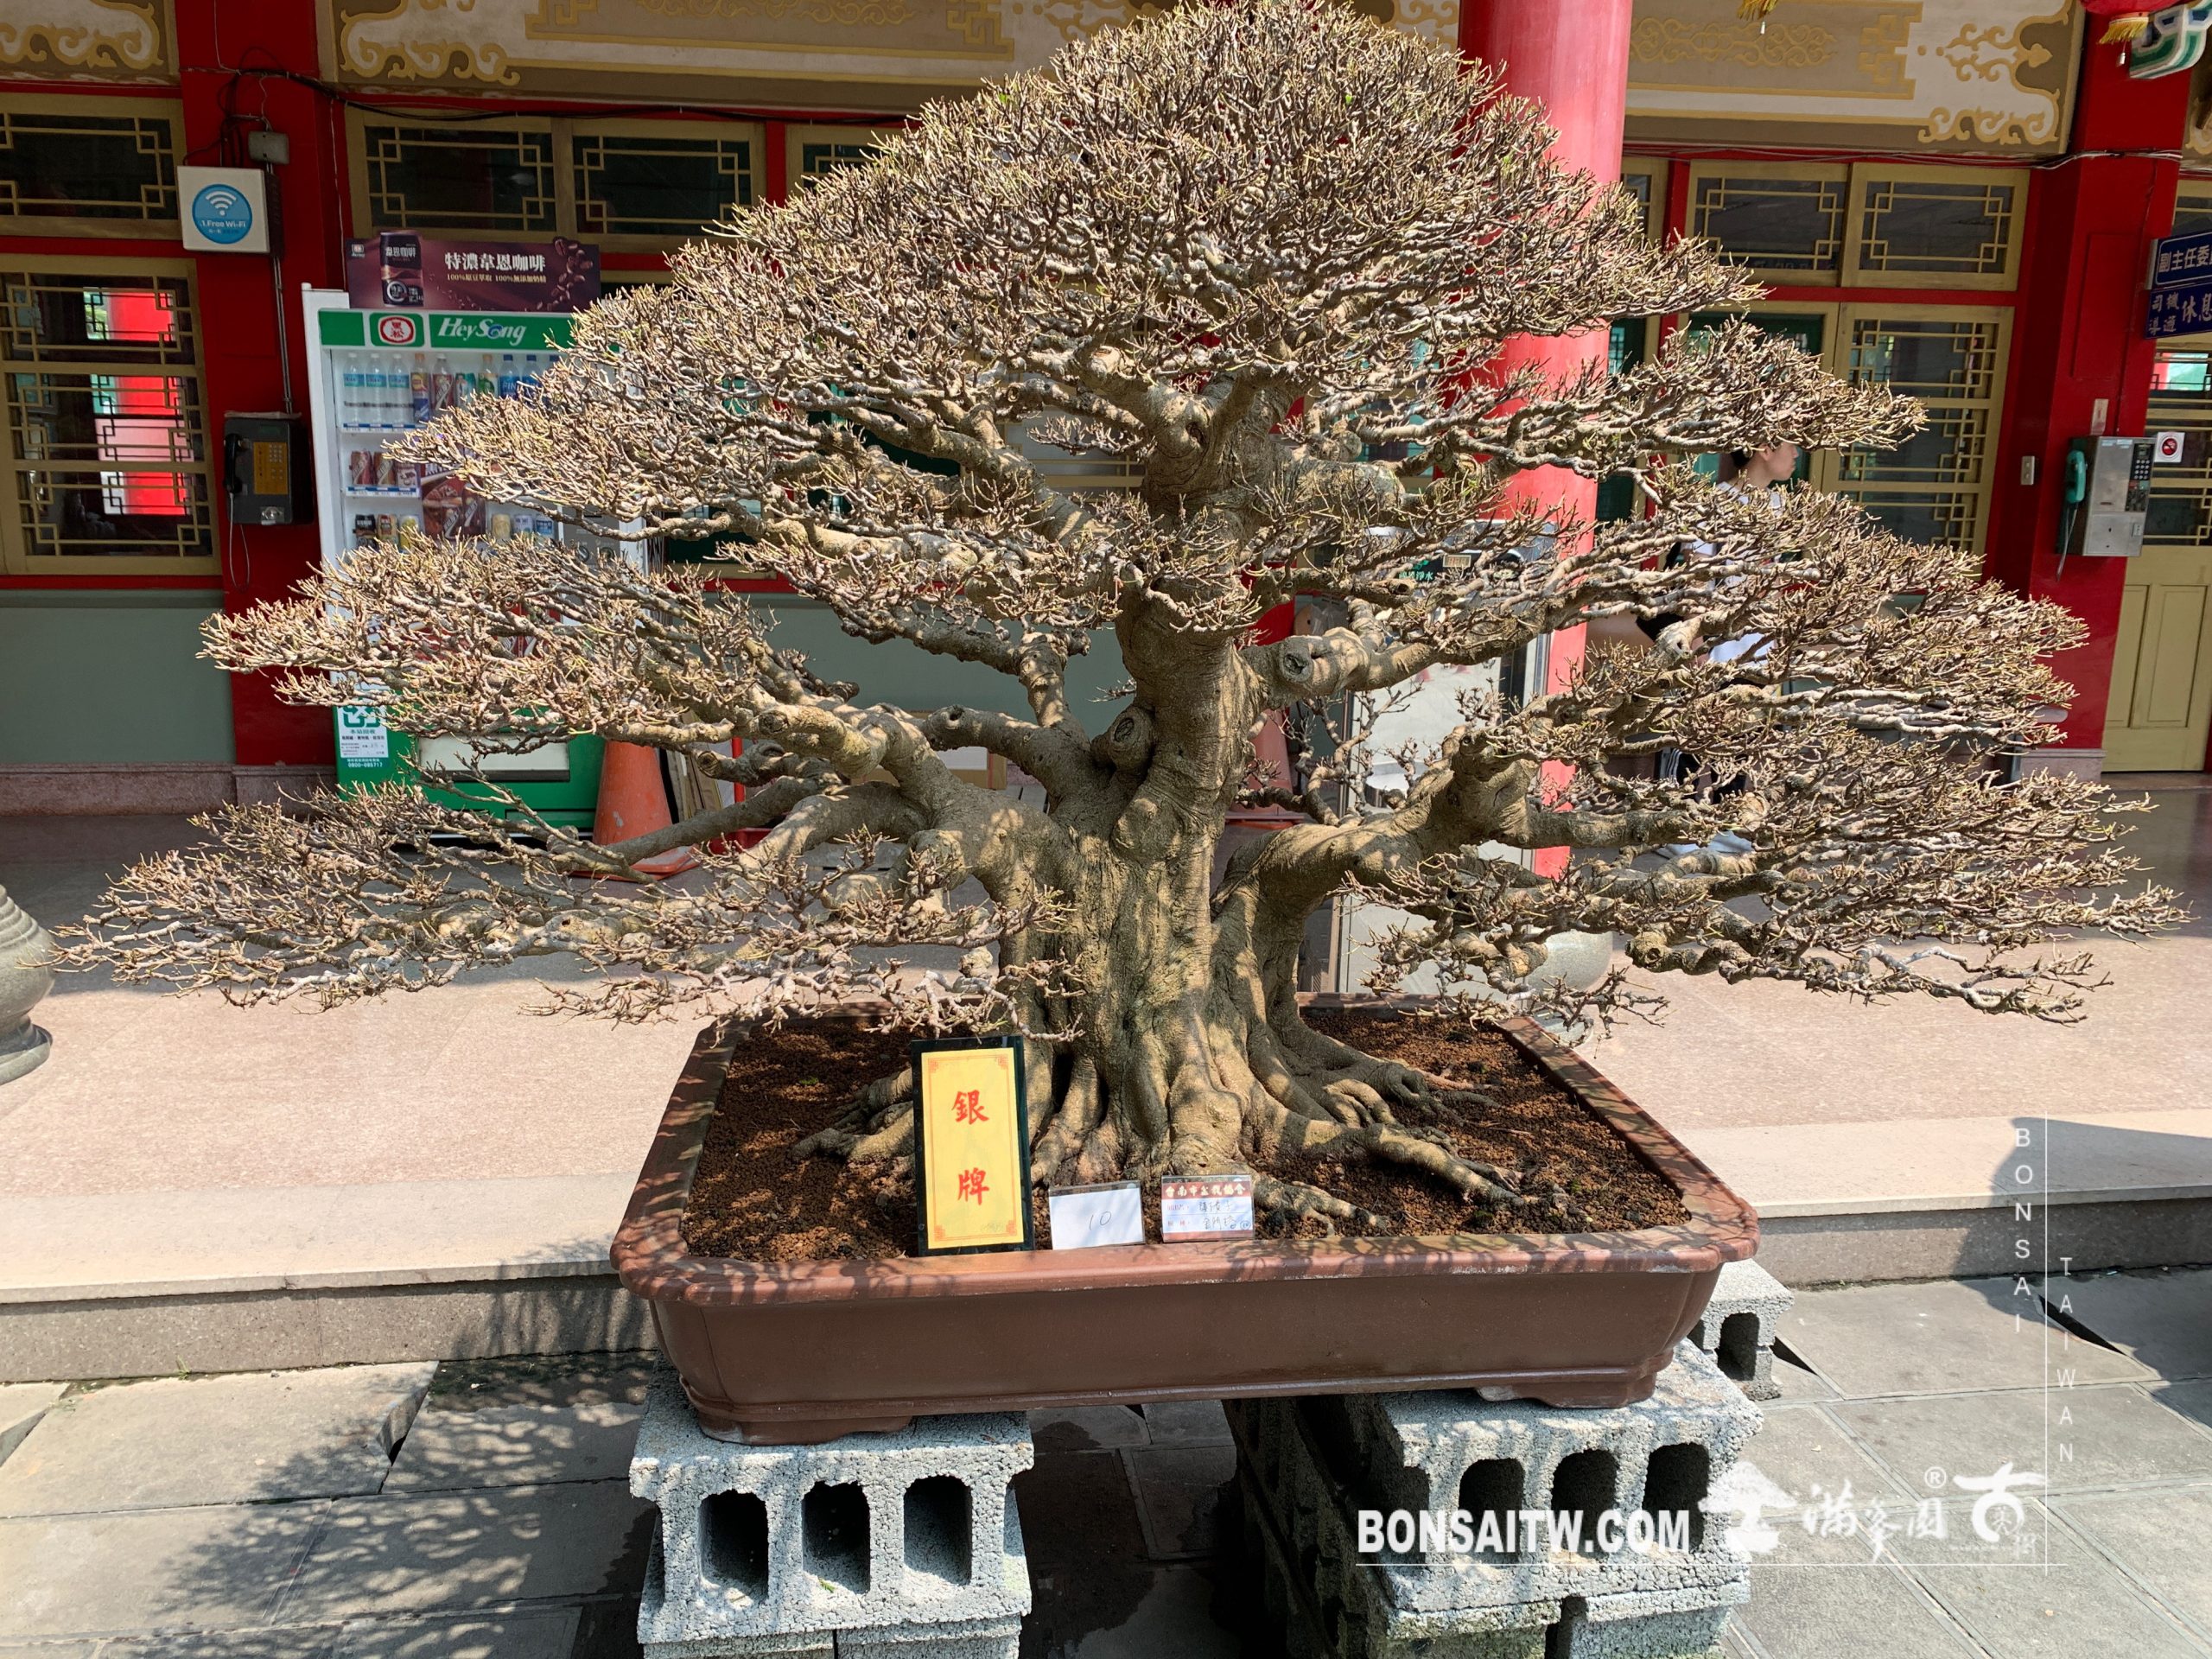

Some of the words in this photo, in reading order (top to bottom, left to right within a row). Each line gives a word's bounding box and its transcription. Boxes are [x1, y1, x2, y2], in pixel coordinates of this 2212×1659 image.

[444, 251, 546, 272] 特濃韋恩咖啡
[2159, 244, 2212, 273] 副主任委
[437, 317, 527, 346] HeySong
[950, 1089, 990, 1206] 銀牌
[1089, 1211, 1112, 1231] 10
